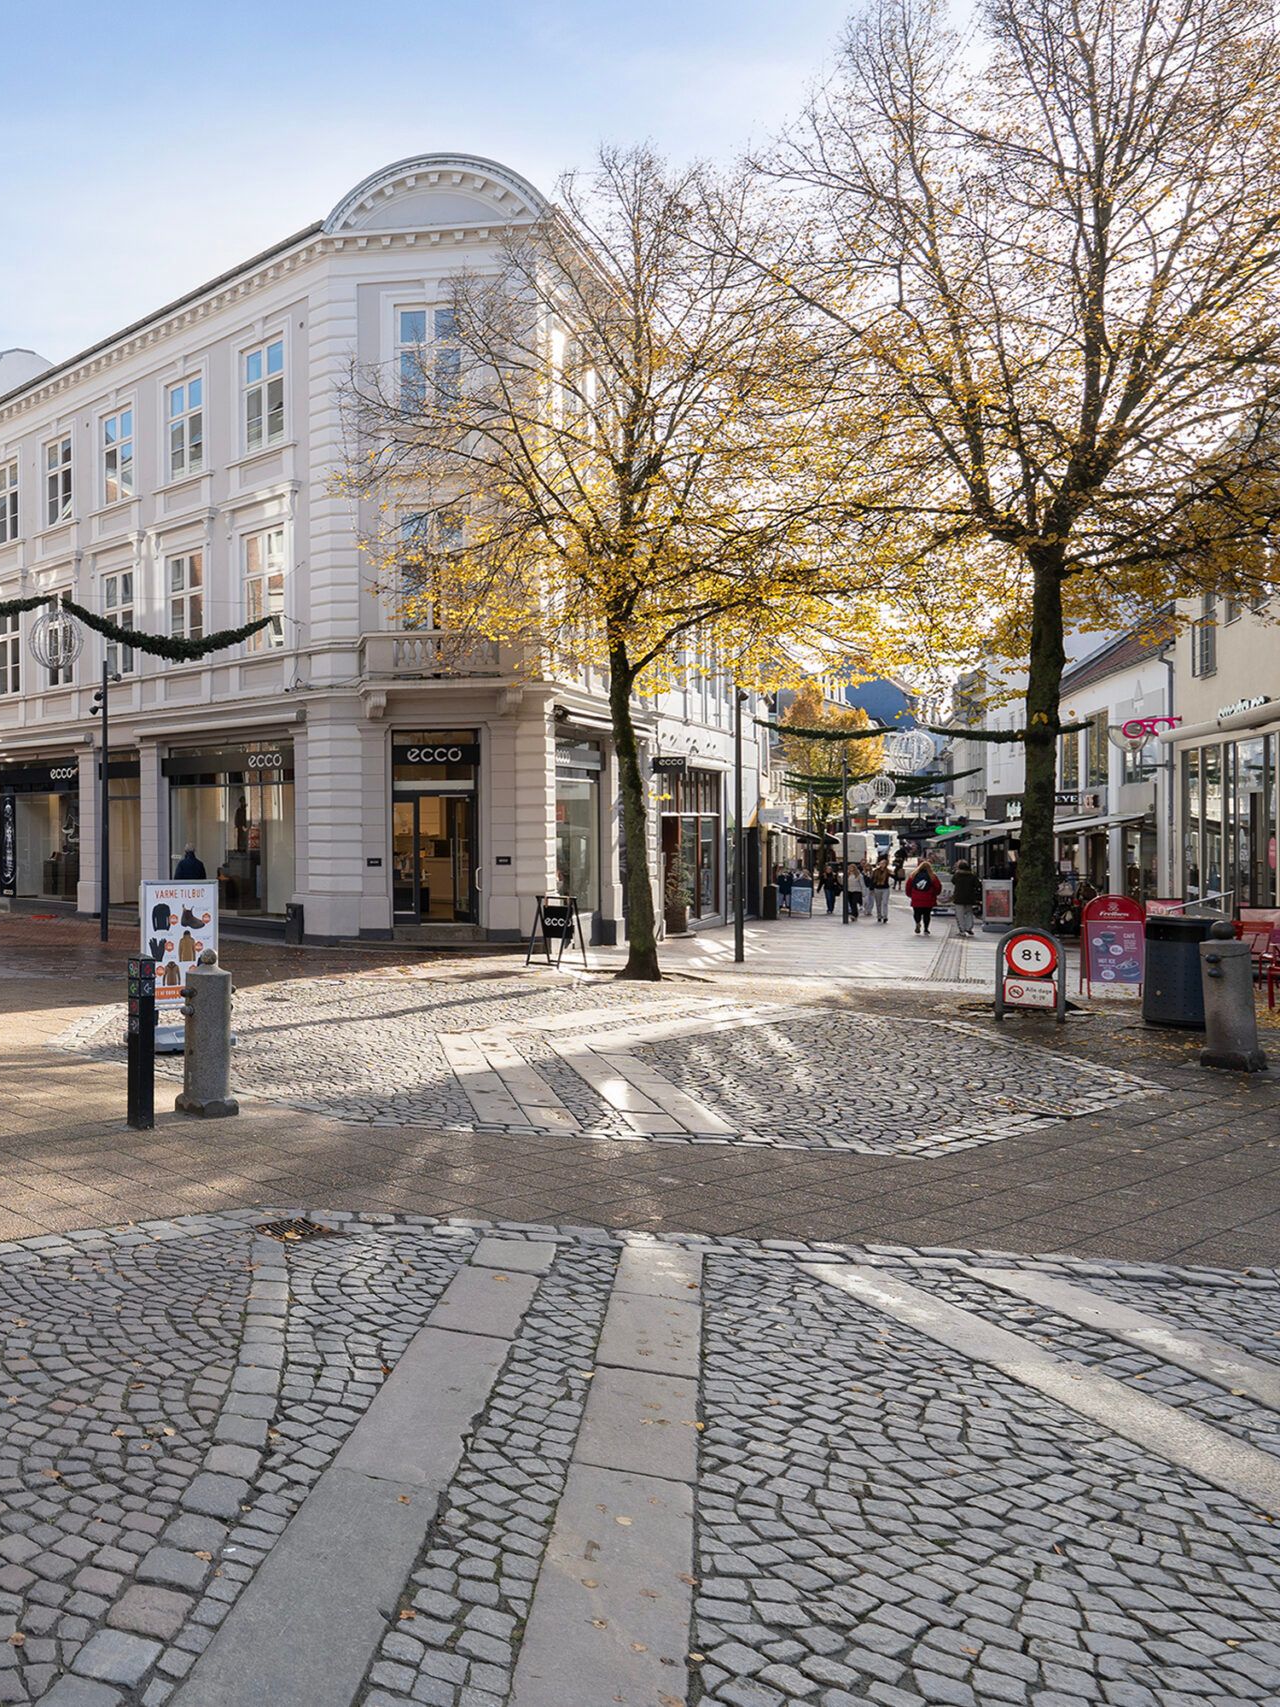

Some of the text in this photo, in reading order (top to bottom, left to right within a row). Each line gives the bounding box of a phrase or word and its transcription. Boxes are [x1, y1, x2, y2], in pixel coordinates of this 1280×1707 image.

[248, 753, 282, 768] ecco
[406, 748, 462, 762] ecco
[50, 767, 74, 779] ecco
